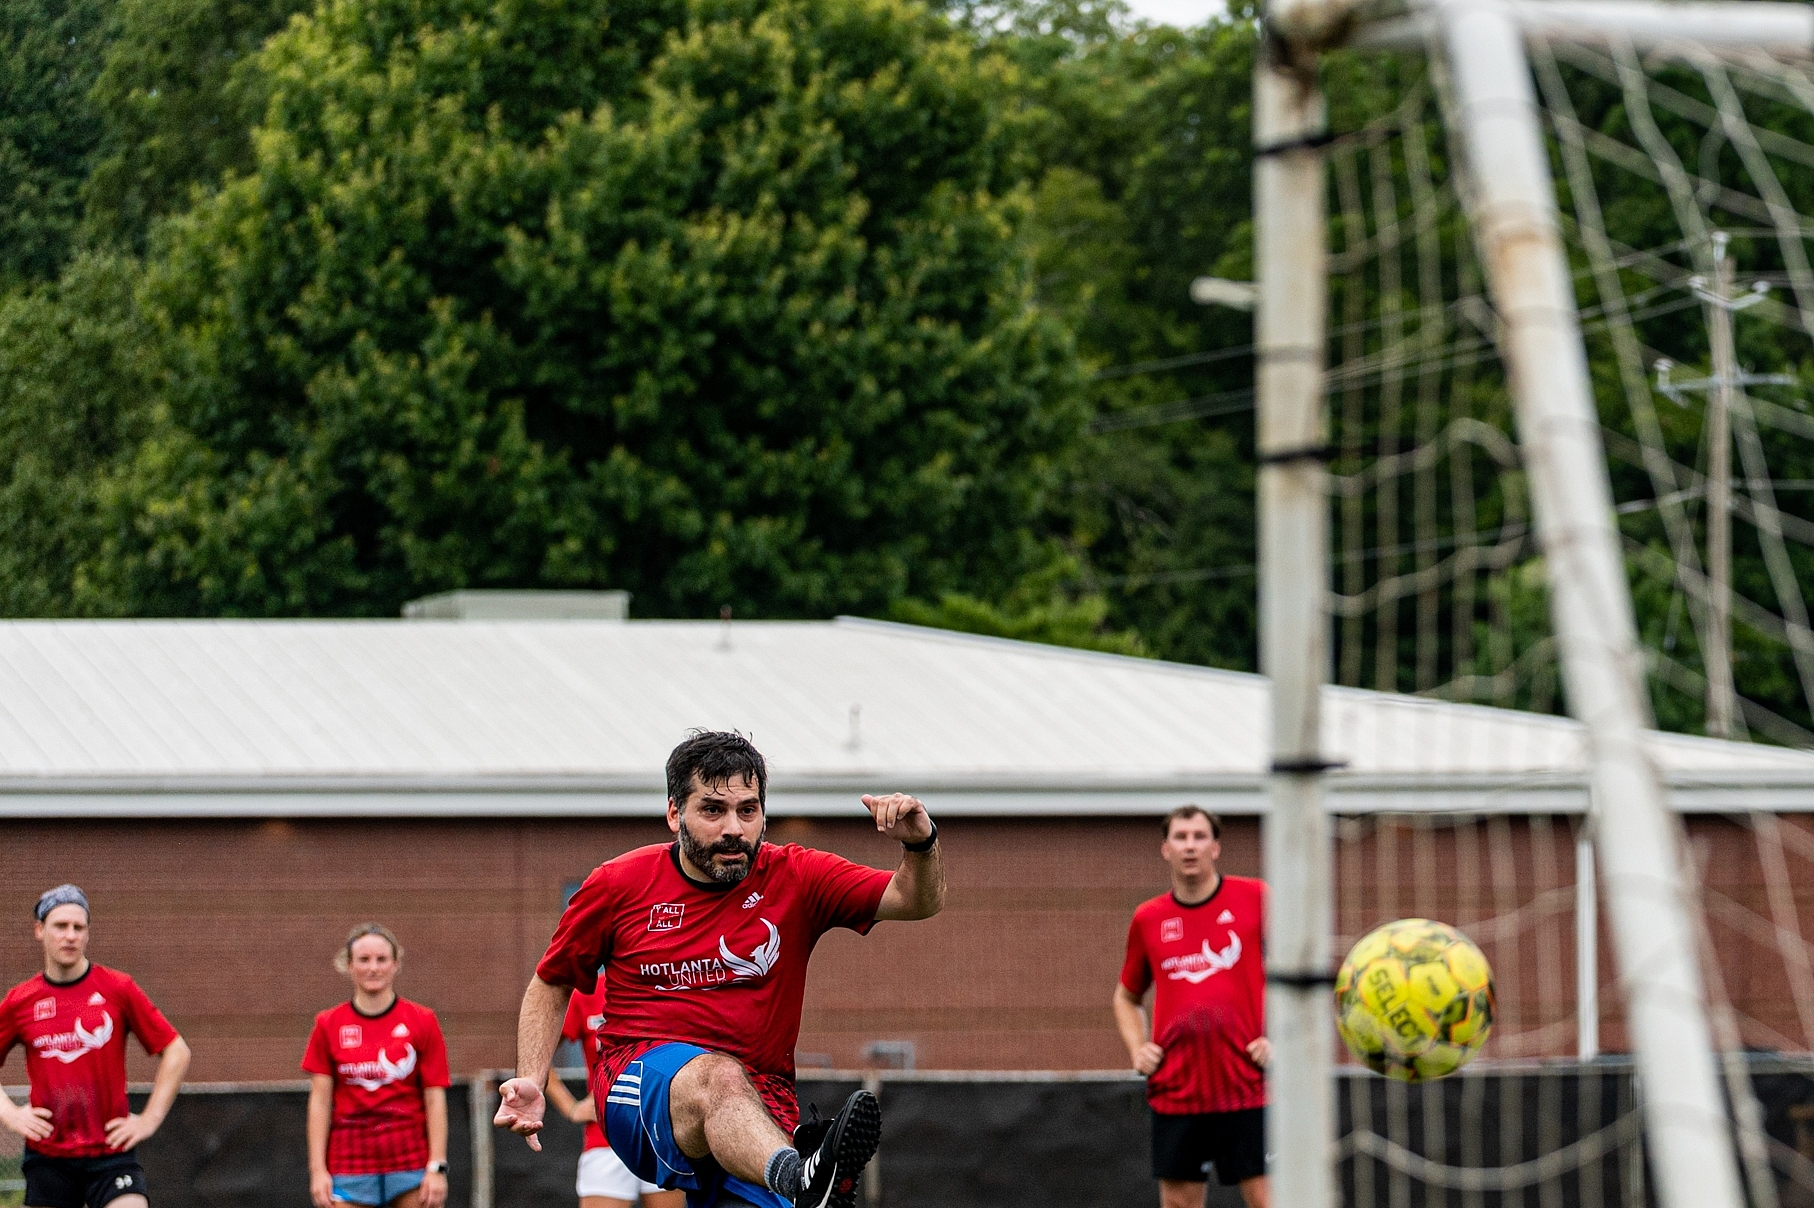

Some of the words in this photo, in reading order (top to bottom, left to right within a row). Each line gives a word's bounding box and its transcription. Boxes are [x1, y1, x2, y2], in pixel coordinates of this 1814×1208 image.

[656, 906, 679, 914] Y'ALL
[640, 958, 722, 976] HOTLANTA
[669, 969, 726, 985] UNITED
[1368, 969, 1427, 1047] SELECT
